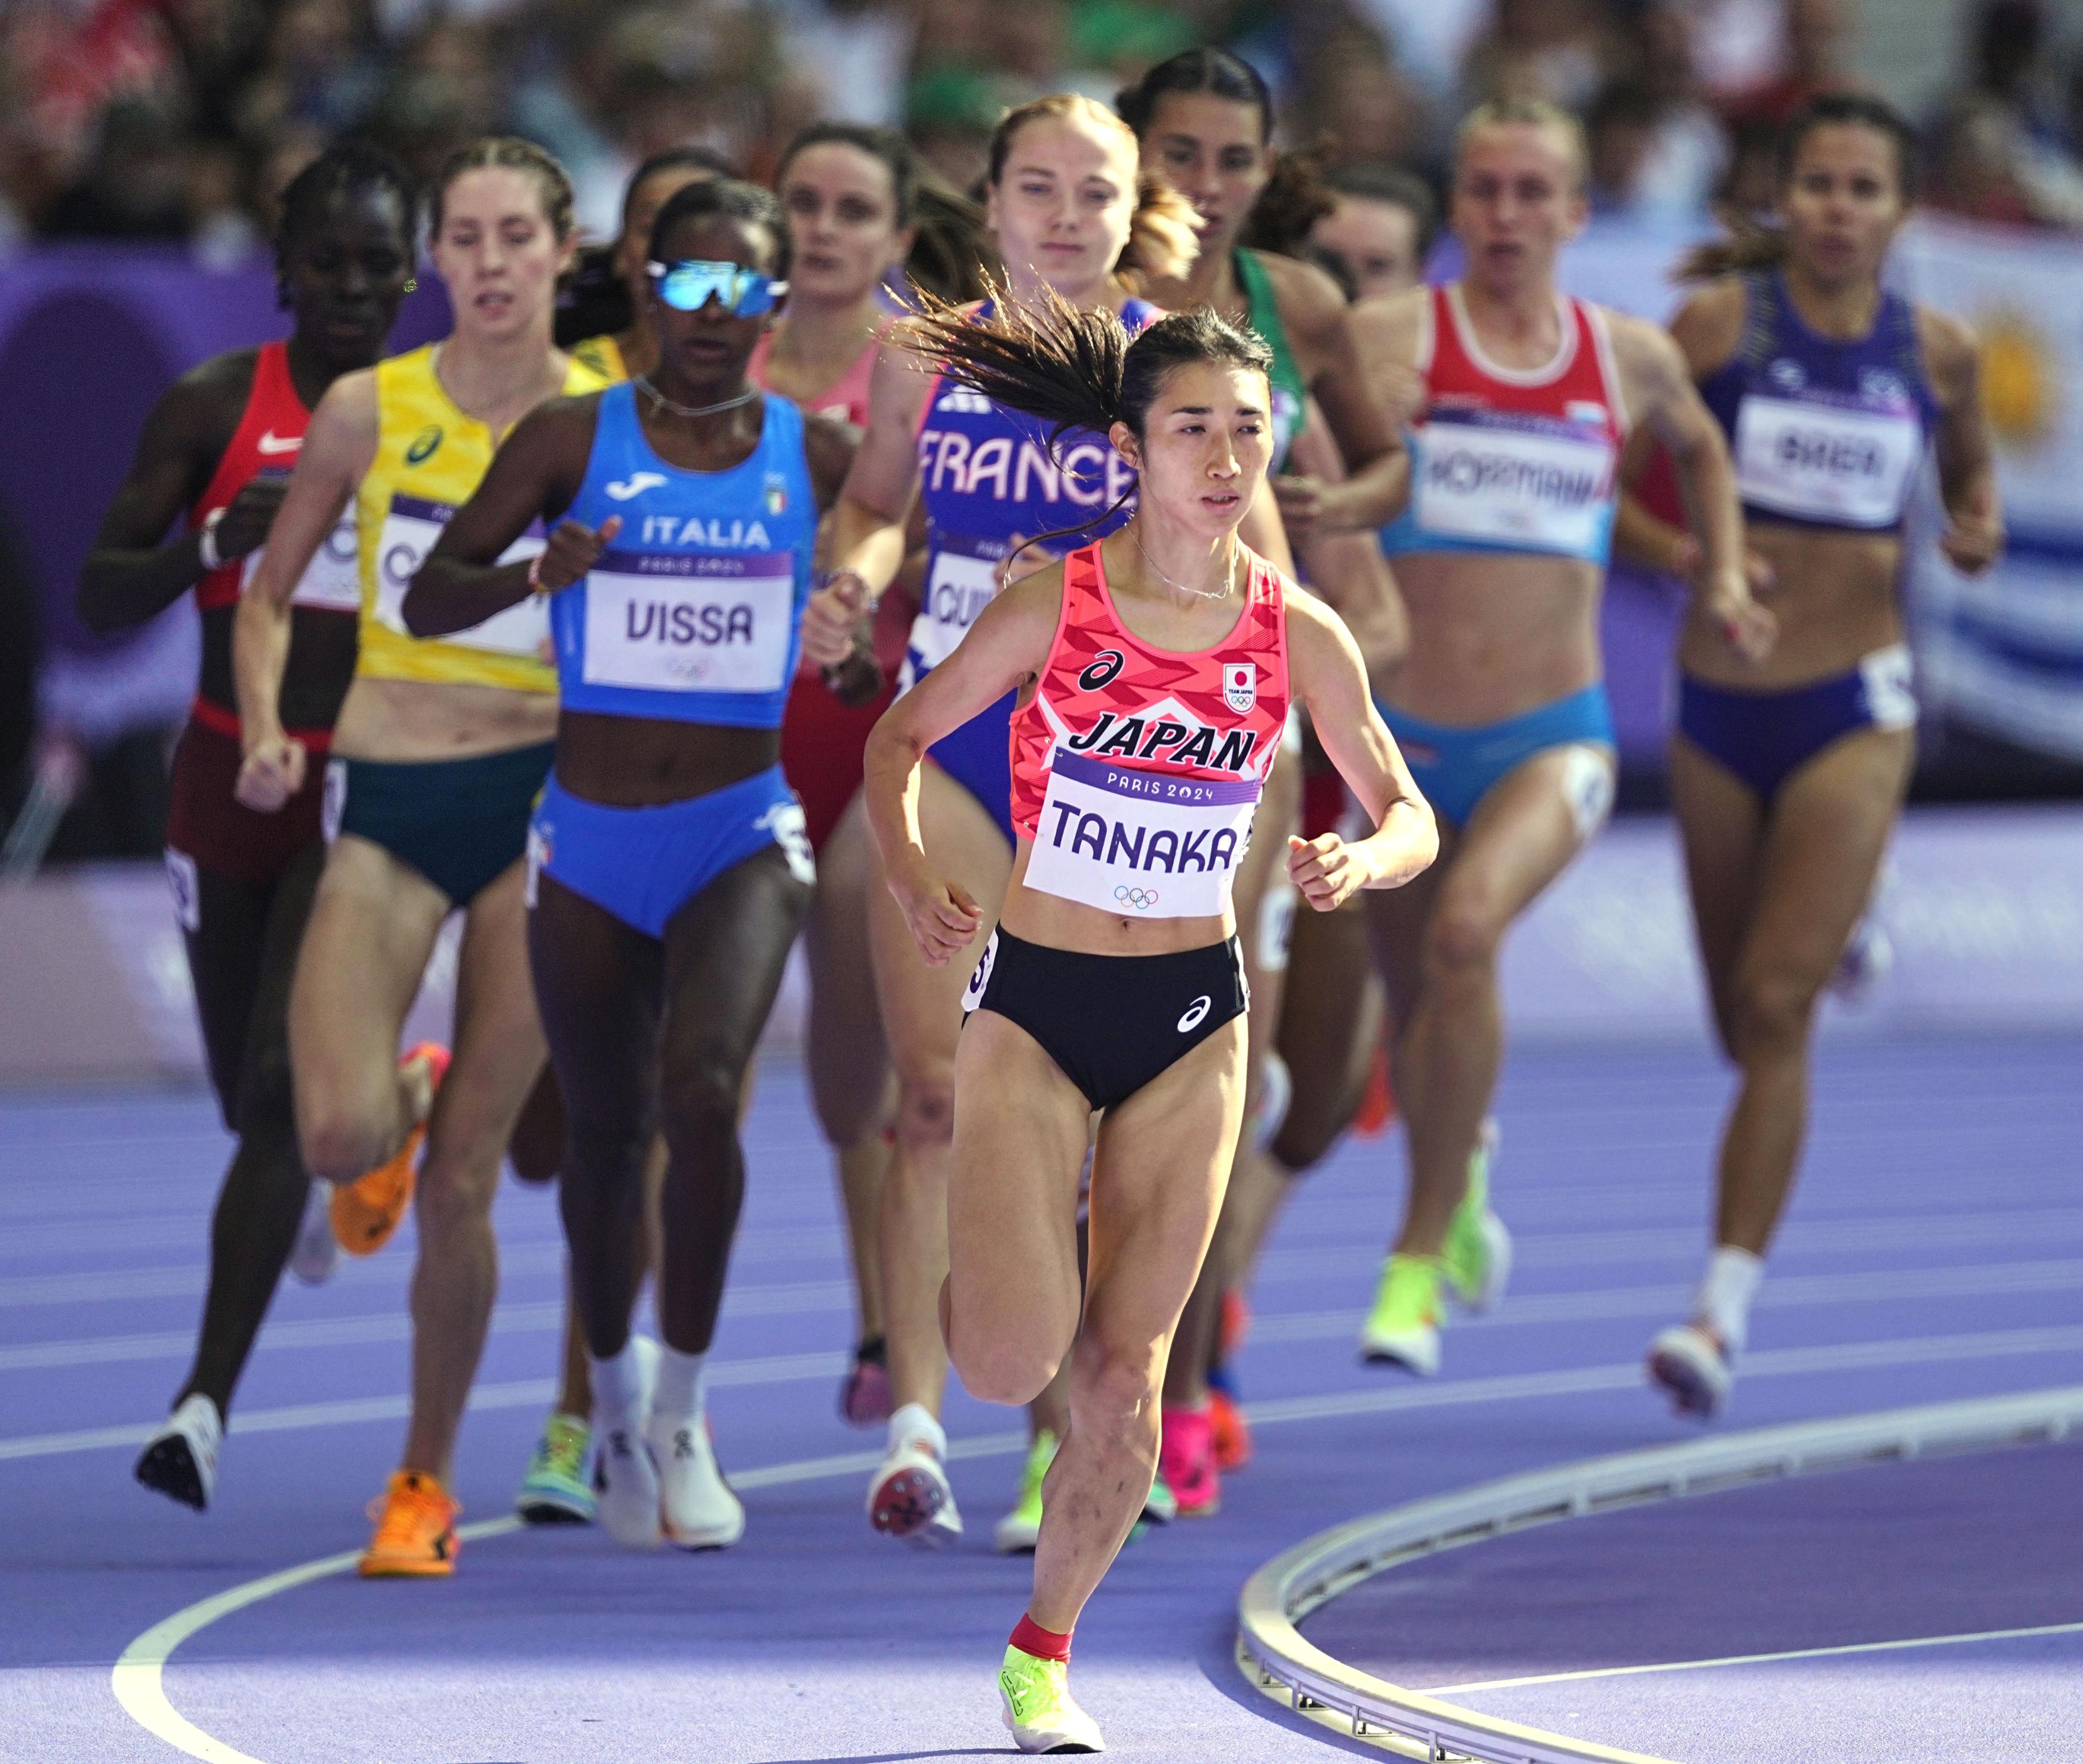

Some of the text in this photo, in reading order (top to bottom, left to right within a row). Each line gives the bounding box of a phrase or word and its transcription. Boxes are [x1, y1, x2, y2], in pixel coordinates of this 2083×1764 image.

[919, 430, 1138, 509] FRANCE
[643, 515, 771, 550] ITALIA
[627, 600, 753, 645] VISSA
[1068, 712, 1256, 772] JAPAN
[1107, 772, 1213, 800] PARIS 2024
[1052, 800, 1237, 873] TANAKA
